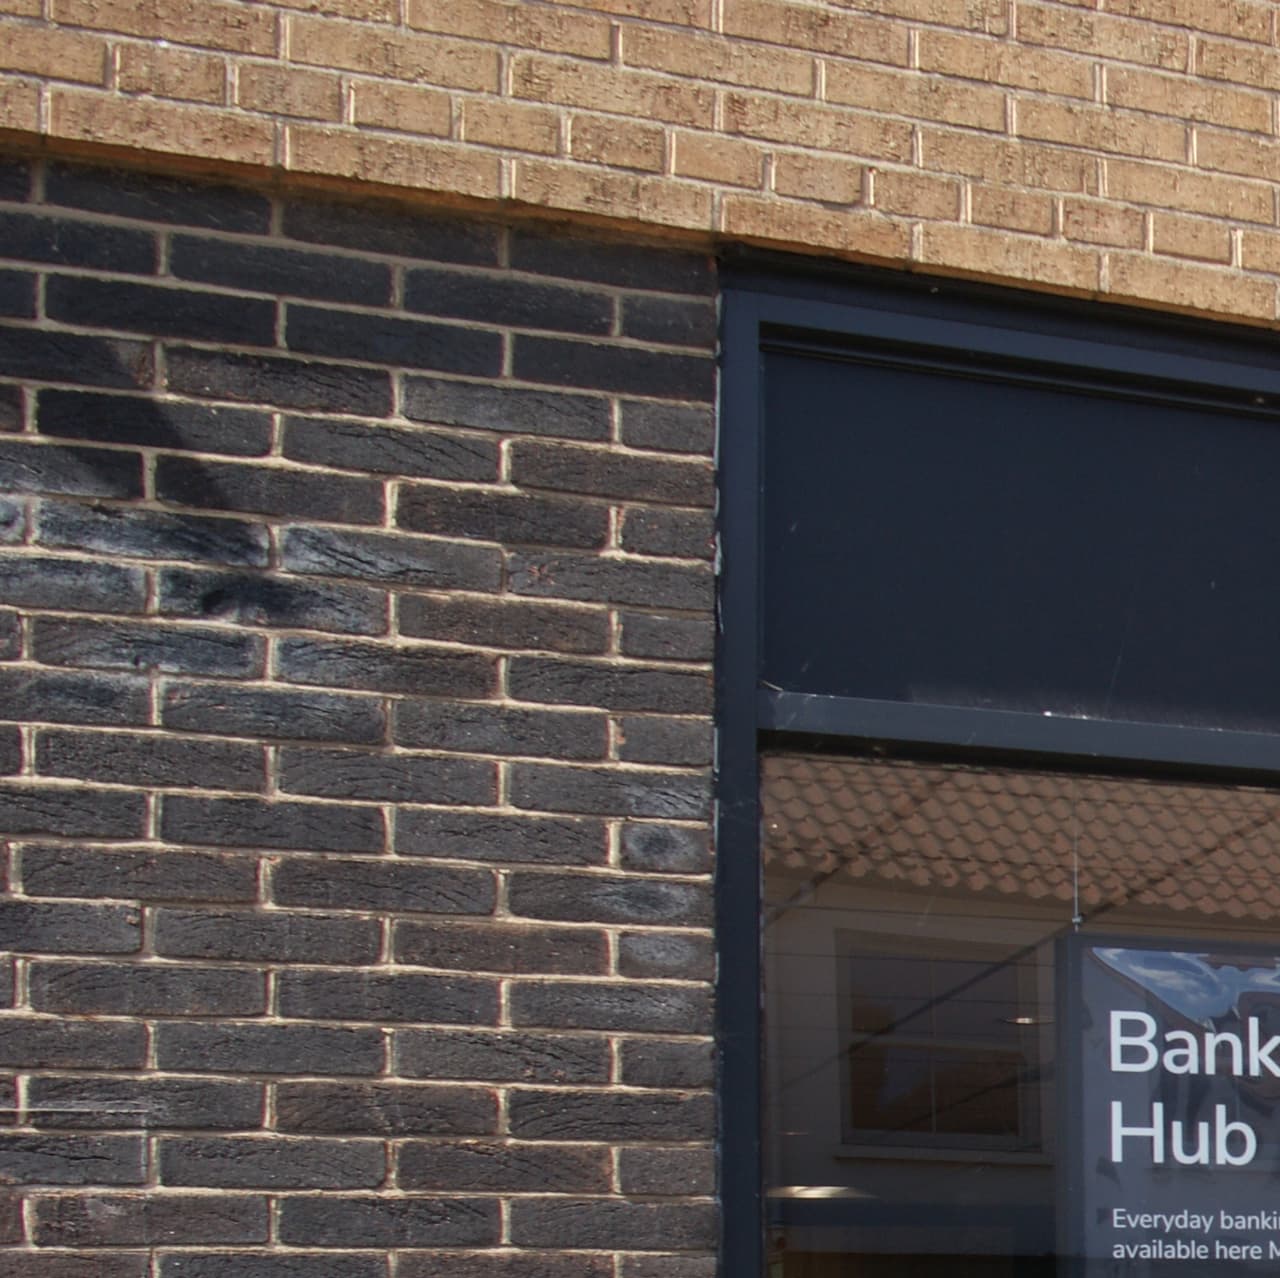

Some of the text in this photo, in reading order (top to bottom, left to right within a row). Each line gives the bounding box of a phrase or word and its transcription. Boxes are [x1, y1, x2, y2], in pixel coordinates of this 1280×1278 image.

[1110, 1100, 1257, 1166] Hub
[1113, 1207, 1214, 1233] Everyday
[1113, 1240, 1209, 1260] available
[1215, 1241, 1262, 1260] here
